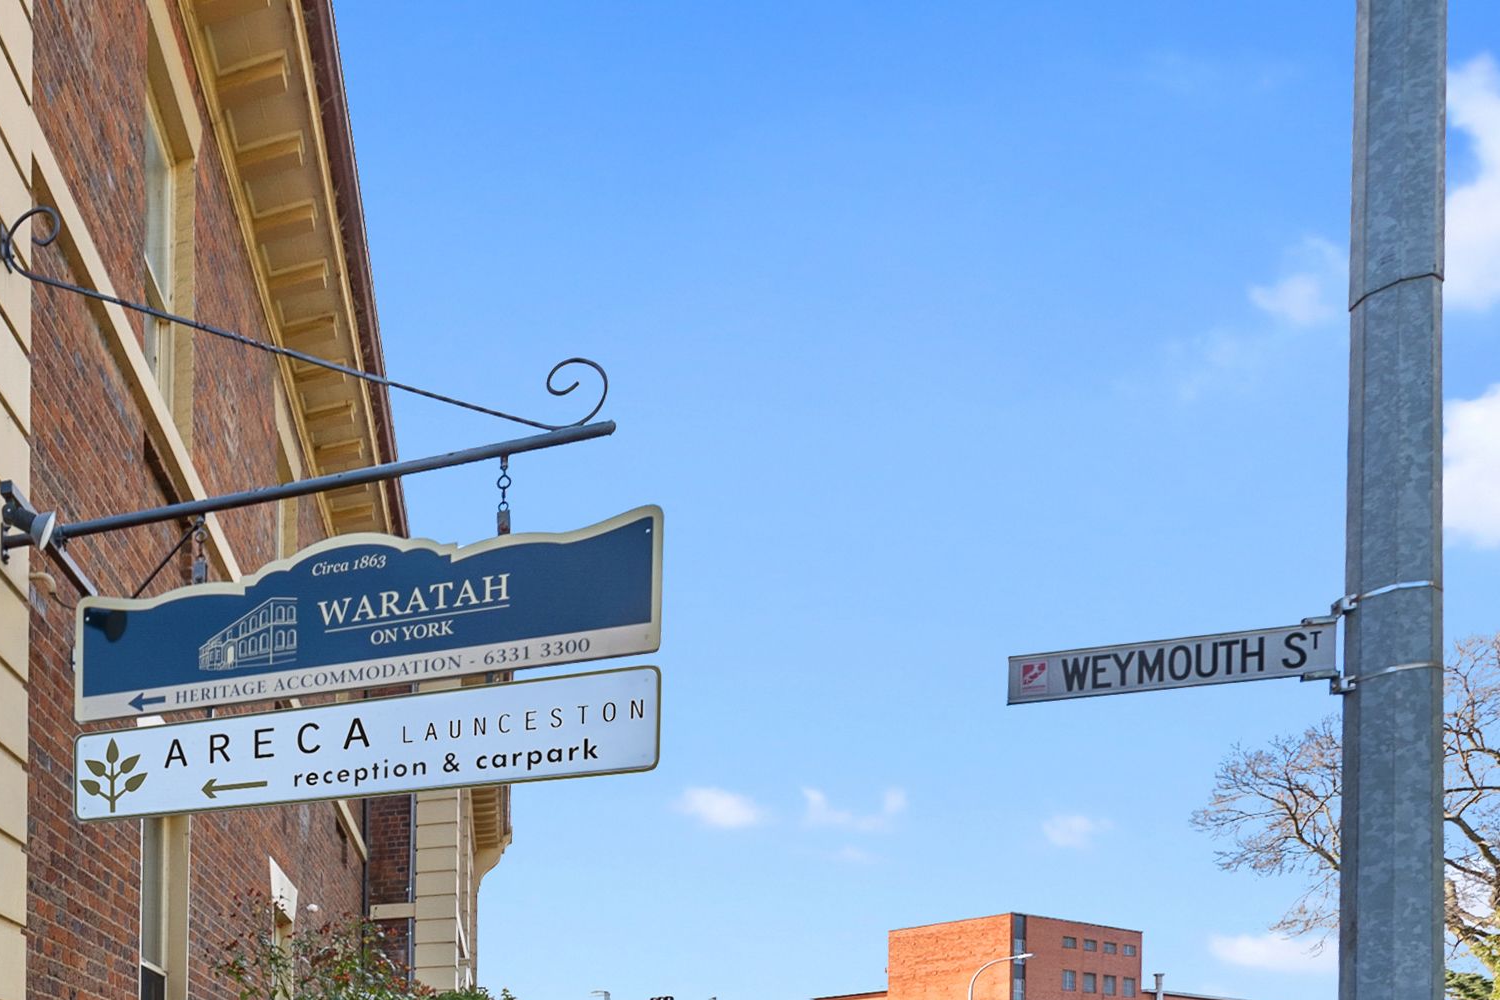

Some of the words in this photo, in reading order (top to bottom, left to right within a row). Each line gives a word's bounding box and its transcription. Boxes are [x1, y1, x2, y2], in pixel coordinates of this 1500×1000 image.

[312, 561, 349, 577] Circa
[353, 554, 387, 570] 1863
[317, 573, 510, 626] WARATAH
[370, 627, 398, 645] ON
[403, 620, 454, 641] YORK
[176, 681, 267, 704] HERITAGE
[273, 655, 463, 693] ACCOMMODATION
[483, 644, 530, 665] 6331
[540, 638, 591, 658] 3300
[1062, 637, 1265, 692] WEYMOUTH
[164, 717, 370, 768] ARECA
[402, 700, 644, 743] LAUNCESTON
[293, 758, 427, 788] reception
[442, 752, 460, 773] &
[476, 738, 598, 770] carpark
